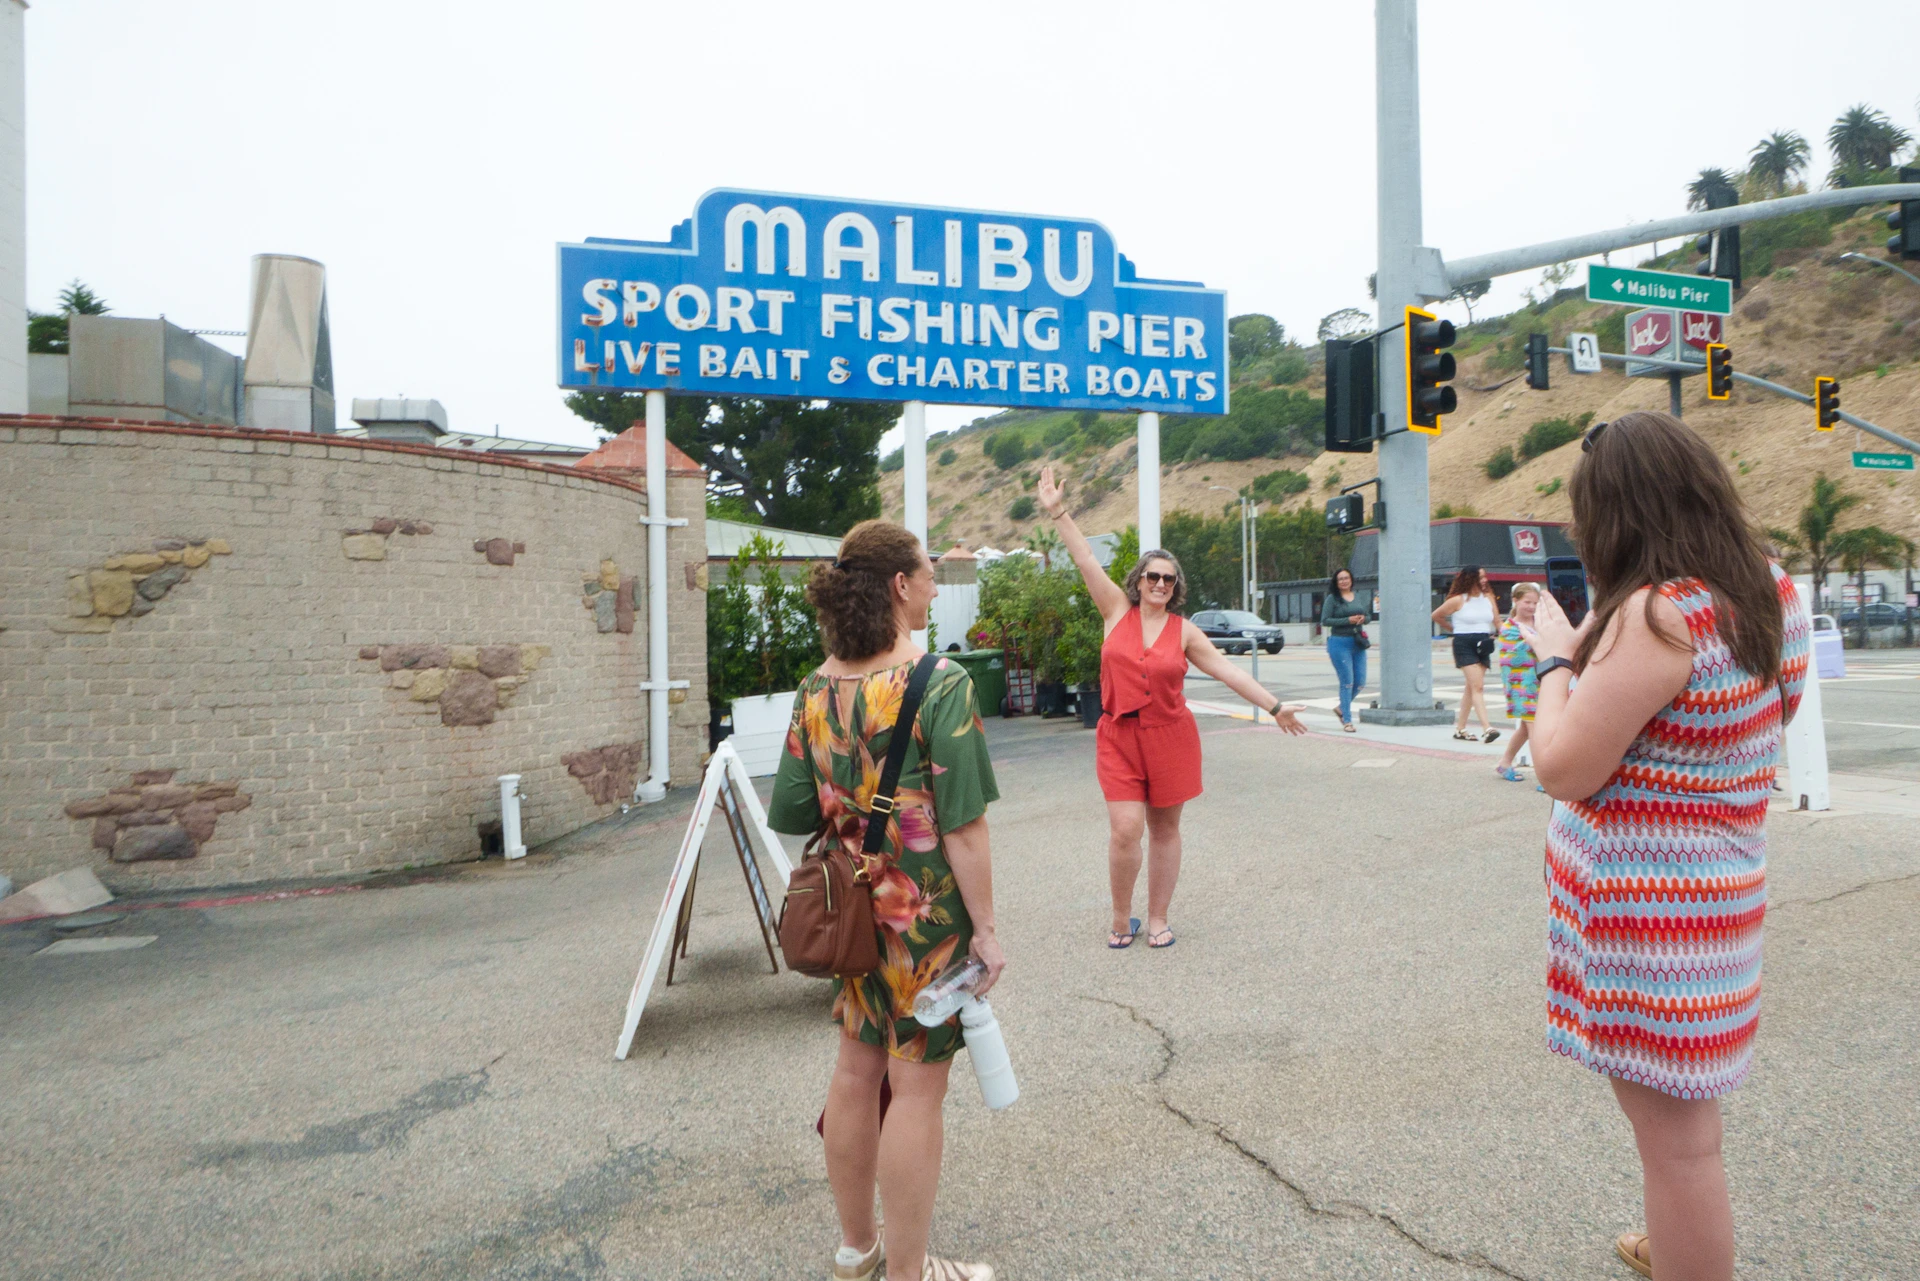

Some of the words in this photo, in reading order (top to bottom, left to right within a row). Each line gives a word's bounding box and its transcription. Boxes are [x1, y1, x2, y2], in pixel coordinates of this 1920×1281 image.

[724, 203, 1094, 298] MALIBU
[1628, 280, 1677, 299] Malibu
[1681, 287, 1710, 303] Pier
[581, 278, 795, 336] SPORT
[821, 293, 1060, 351] FISHING
[1088, 310, 1207, 360] PIER
[1631, 316, 1670, 352] Jack
[1684, 313, 1721, 343] Jack
[574, 338, 681, 378] LIVE
[699, 344, 810, 382] BAIT
[827, 356, 852, 384] &
[867, 353, 1070, 394] CHARTER
[1086, 364, 1216, 402] BOATS
